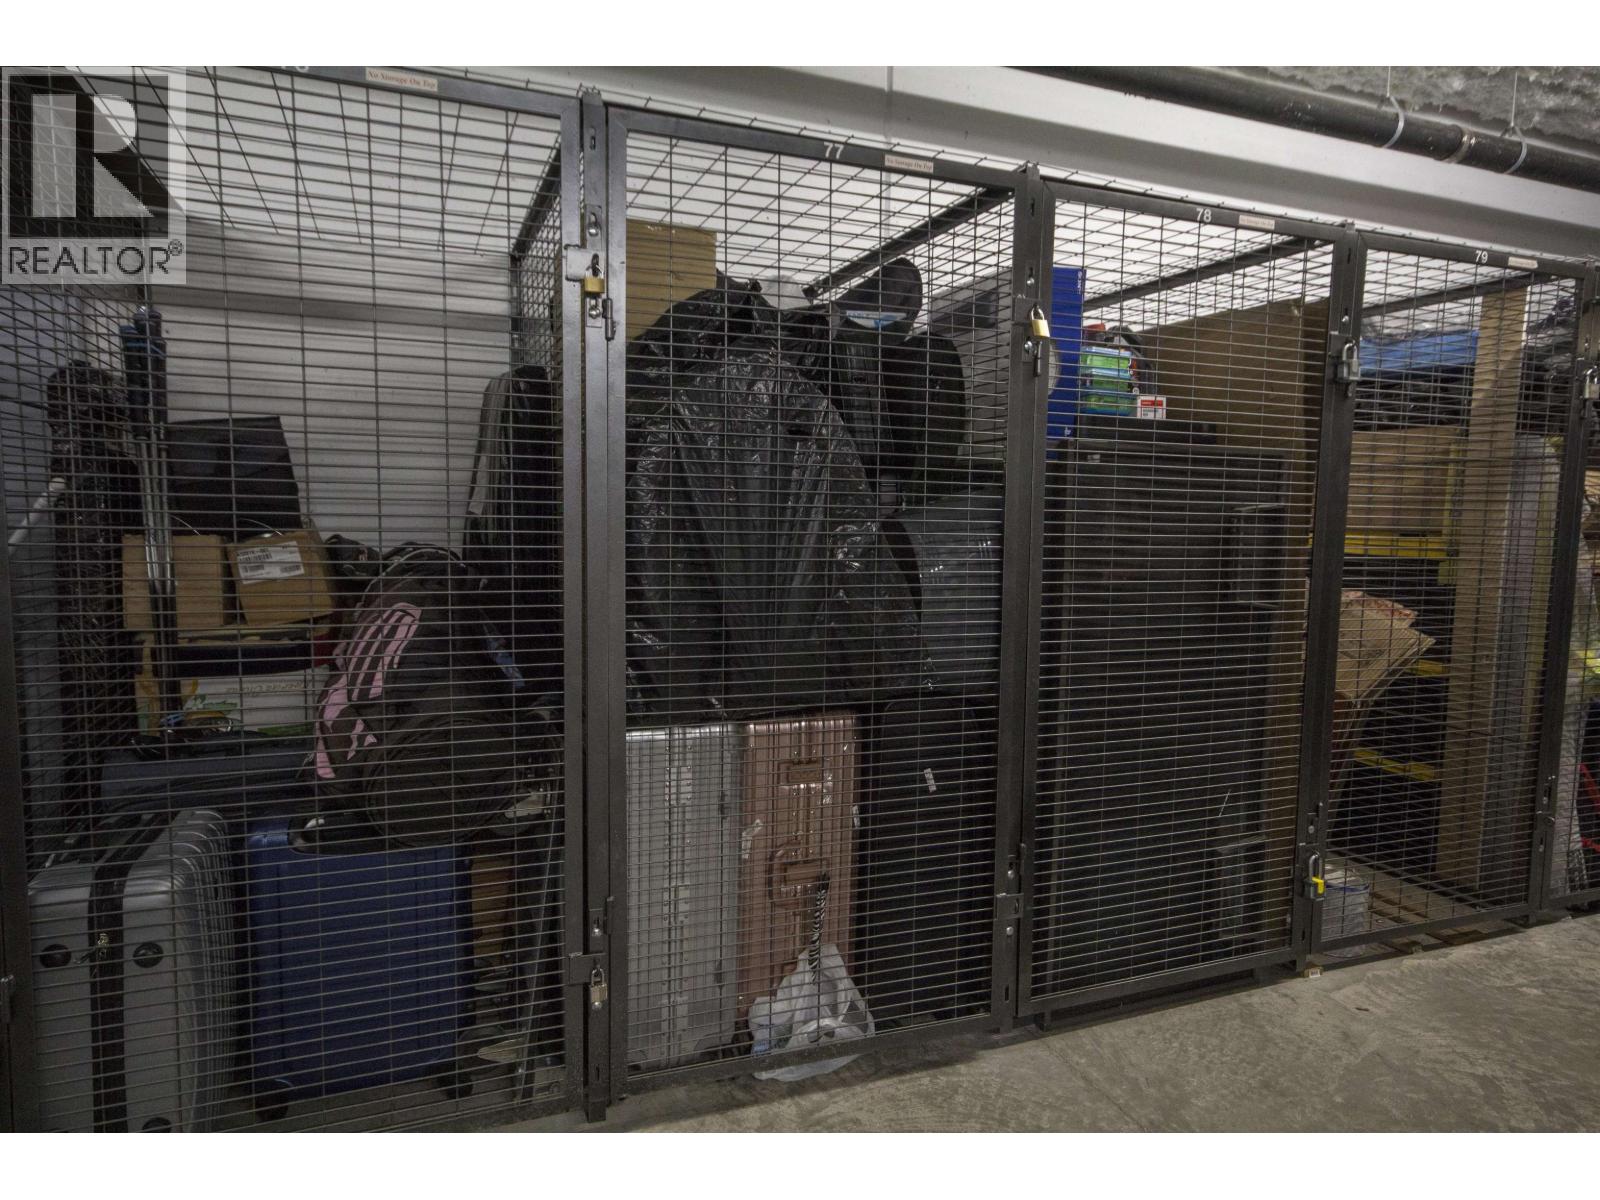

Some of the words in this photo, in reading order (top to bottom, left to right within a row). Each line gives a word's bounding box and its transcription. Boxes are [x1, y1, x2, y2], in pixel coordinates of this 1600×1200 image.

[824, 141, 844, 159] 77
[1196, 208, 1211, 223] 78
[1475, 250, 1488, 264] 79
